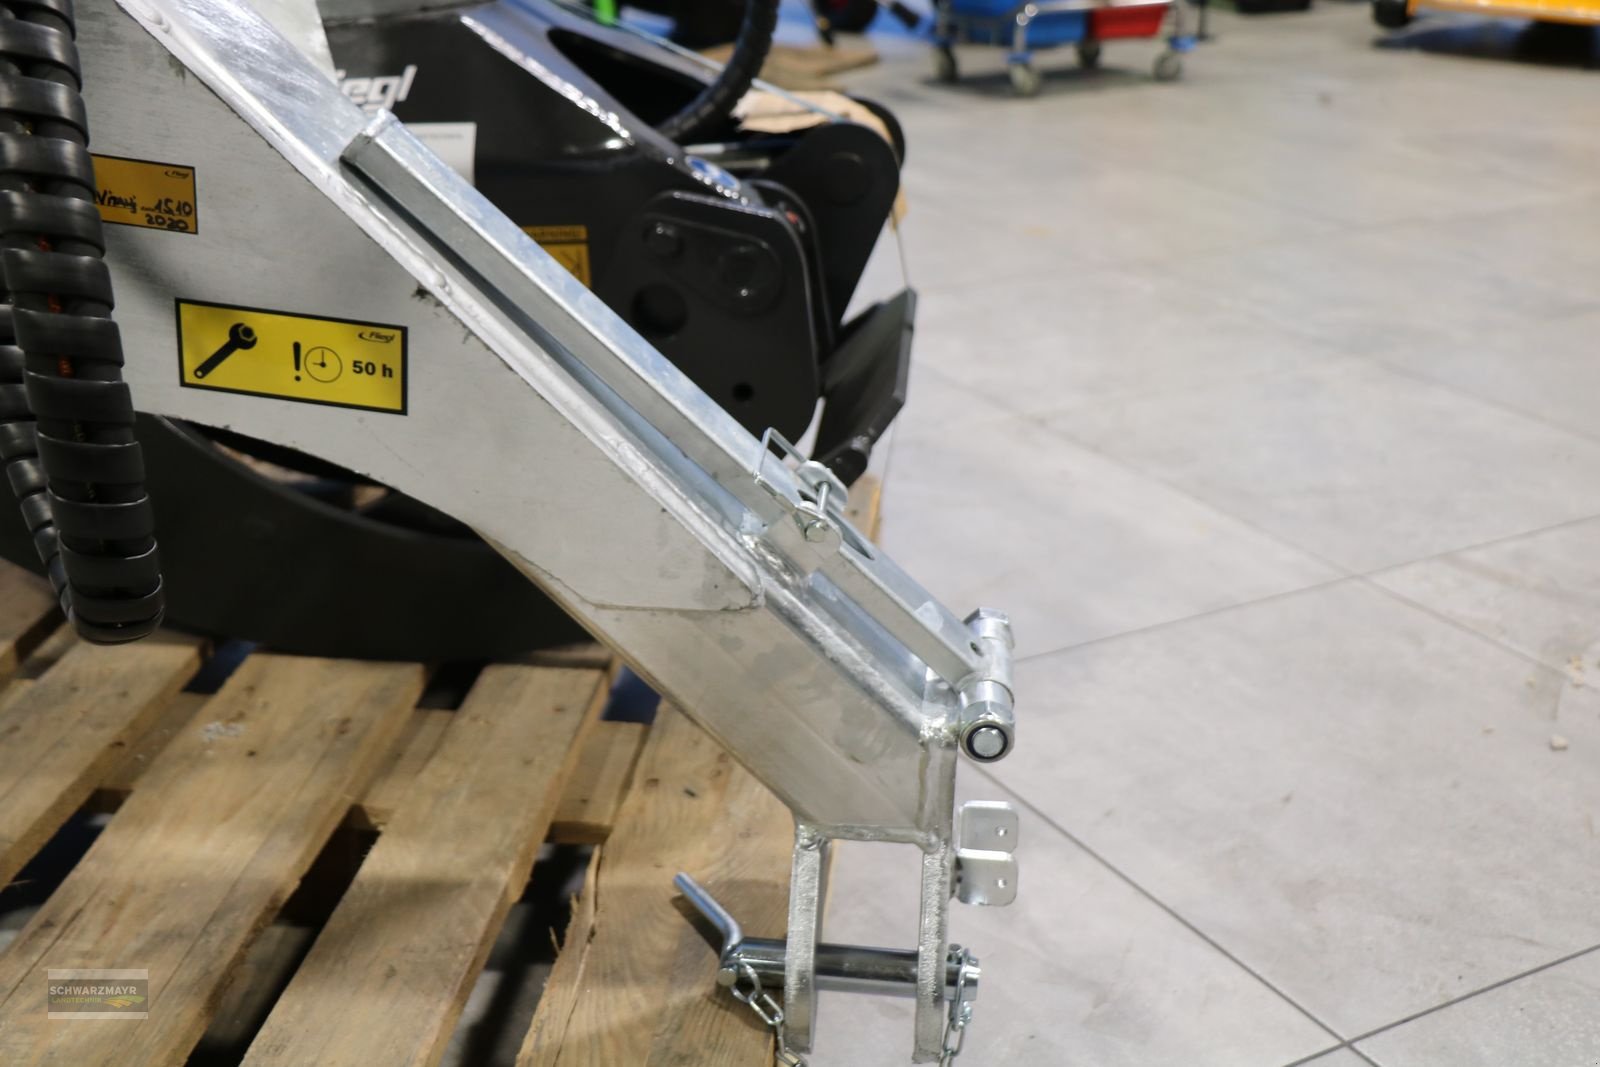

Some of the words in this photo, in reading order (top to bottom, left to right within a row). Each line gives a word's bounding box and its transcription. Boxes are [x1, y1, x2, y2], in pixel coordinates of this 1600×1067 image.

[369, 331, 395, 344] Fliegl
[352, 360, 376, 376] 50
[382, 363, 393, 378] h
